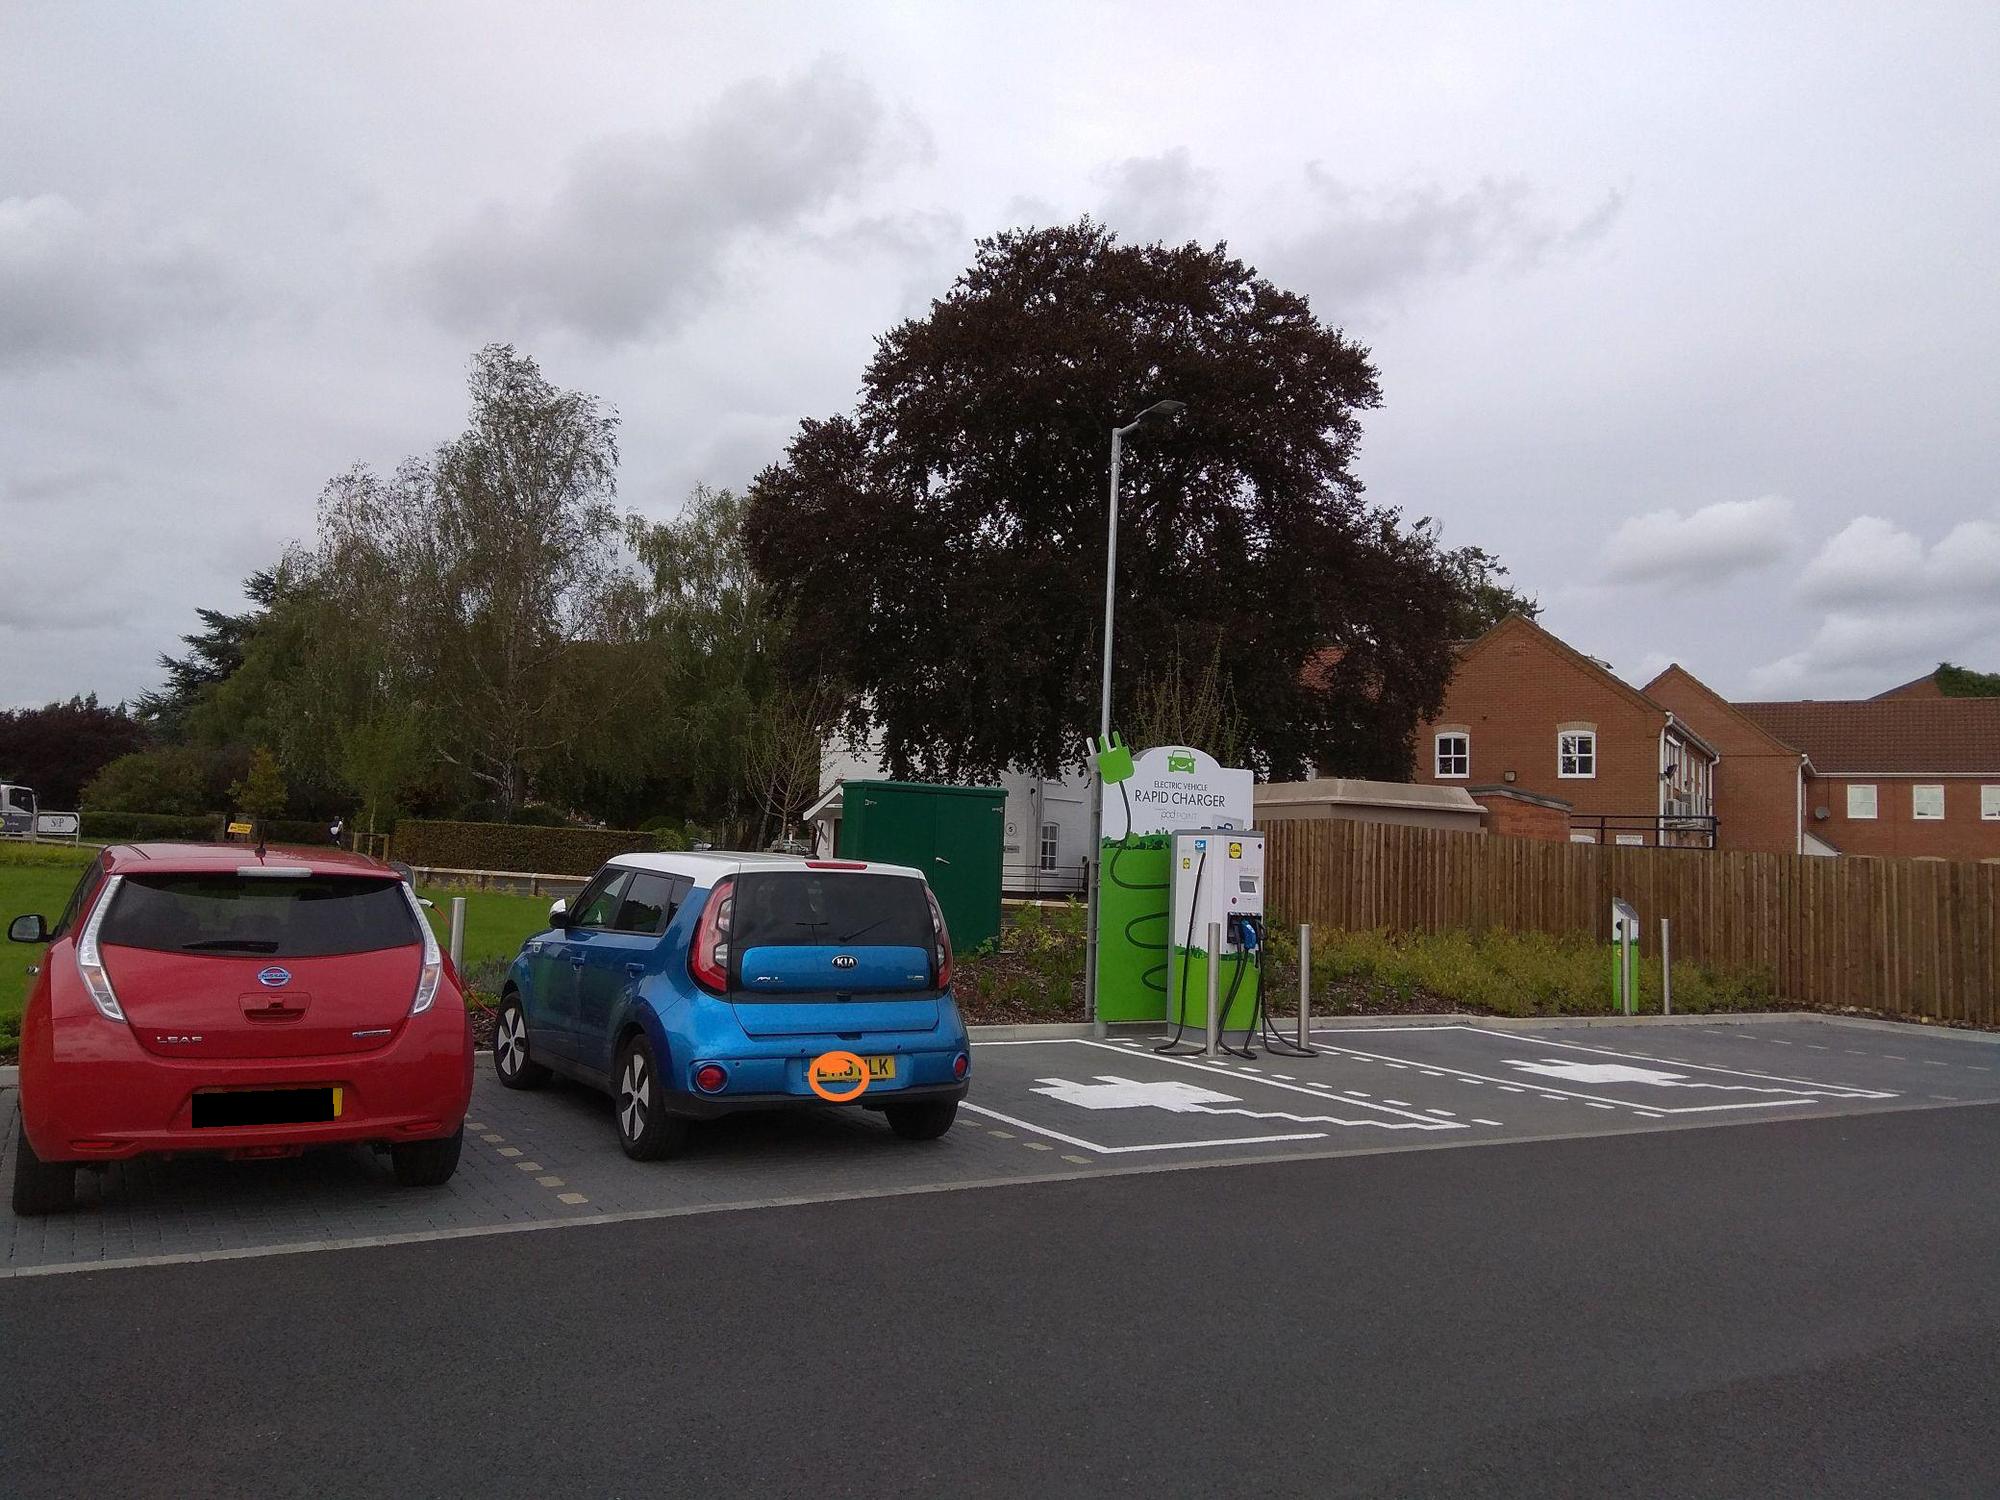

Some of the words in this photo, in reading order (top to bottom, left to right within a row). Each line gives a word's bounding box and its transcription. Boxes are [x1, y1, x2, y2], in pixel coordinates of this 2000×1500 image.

[1154, 780, 1182, 790] ELECTRIC
[1183, 783, 1208, 792] VEHICLE
[1135, 789, 1169, 804] RAPID
[1171, 792, 1225, 808] CHARGER
[836, 957, 854, 967] KIA
[156, 1036, 203, 1044] LEAF
